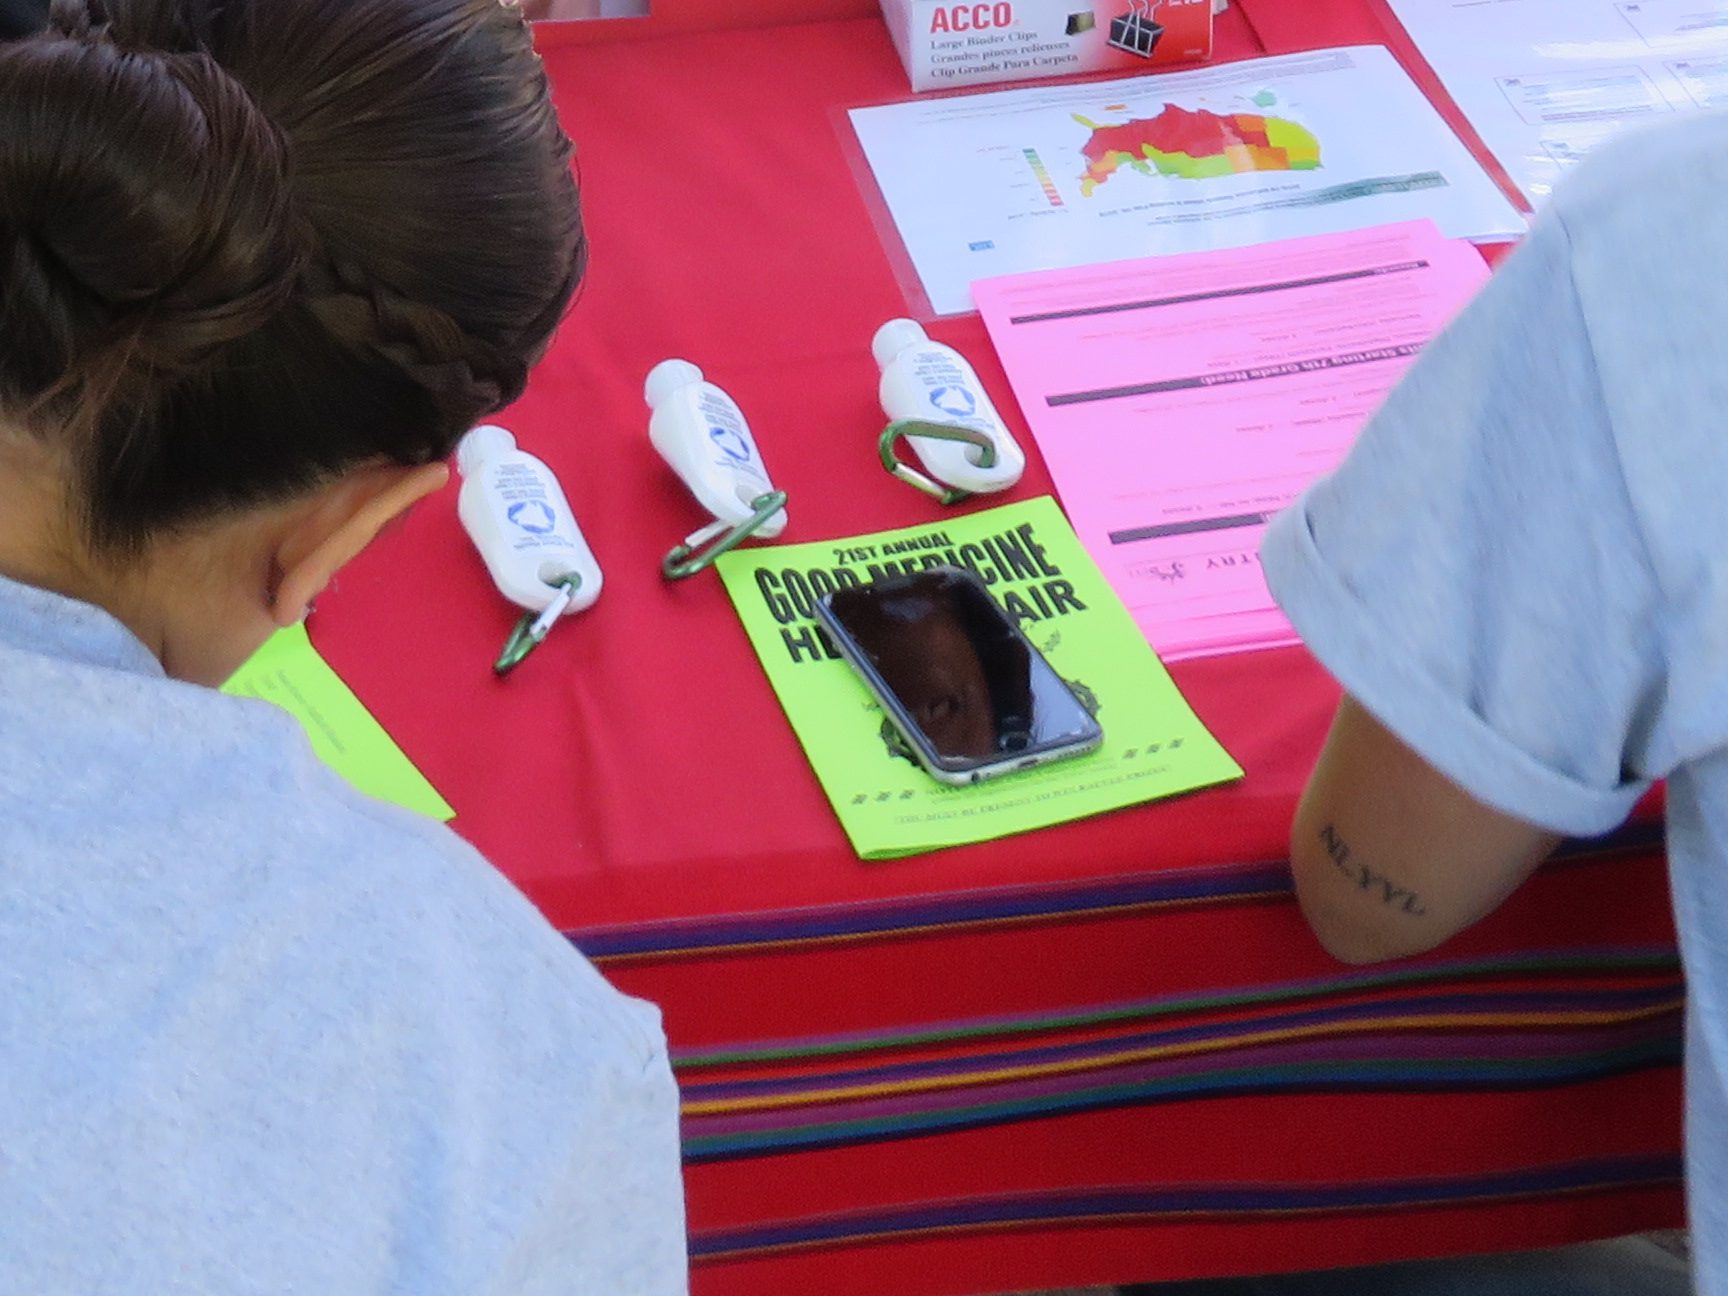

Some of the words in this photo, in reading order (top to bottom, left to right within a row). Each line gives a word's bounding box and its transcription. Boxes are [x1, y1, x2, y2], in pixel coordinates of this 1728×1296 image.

[930, 1, 1012, 33] ACCO
[930, 38, 964, 51] Large
[966, 35, 1005, 47] Binder
[1009, 31, 1038, 44] Clips
[930, 51, 981, 64] Grandes
[981, 48, 1019, 61] pinces
[930, 67, 957, 79] Clip
[958, 62, 1002, 75] Grande
[1003, 59, 1031, 70] Para
[1032, 53, 1079, 68] Carpeta
[1333, 346, 1398, 368] Starting
[1200, 372, 1249, 387] Need)
[1251, 363, 1300, 378] Grade
[832, 539, 883, 567] 21ST
[880, 531, 957, 559] ANNUAL
[1006, 579, 1090, 625] AIR
